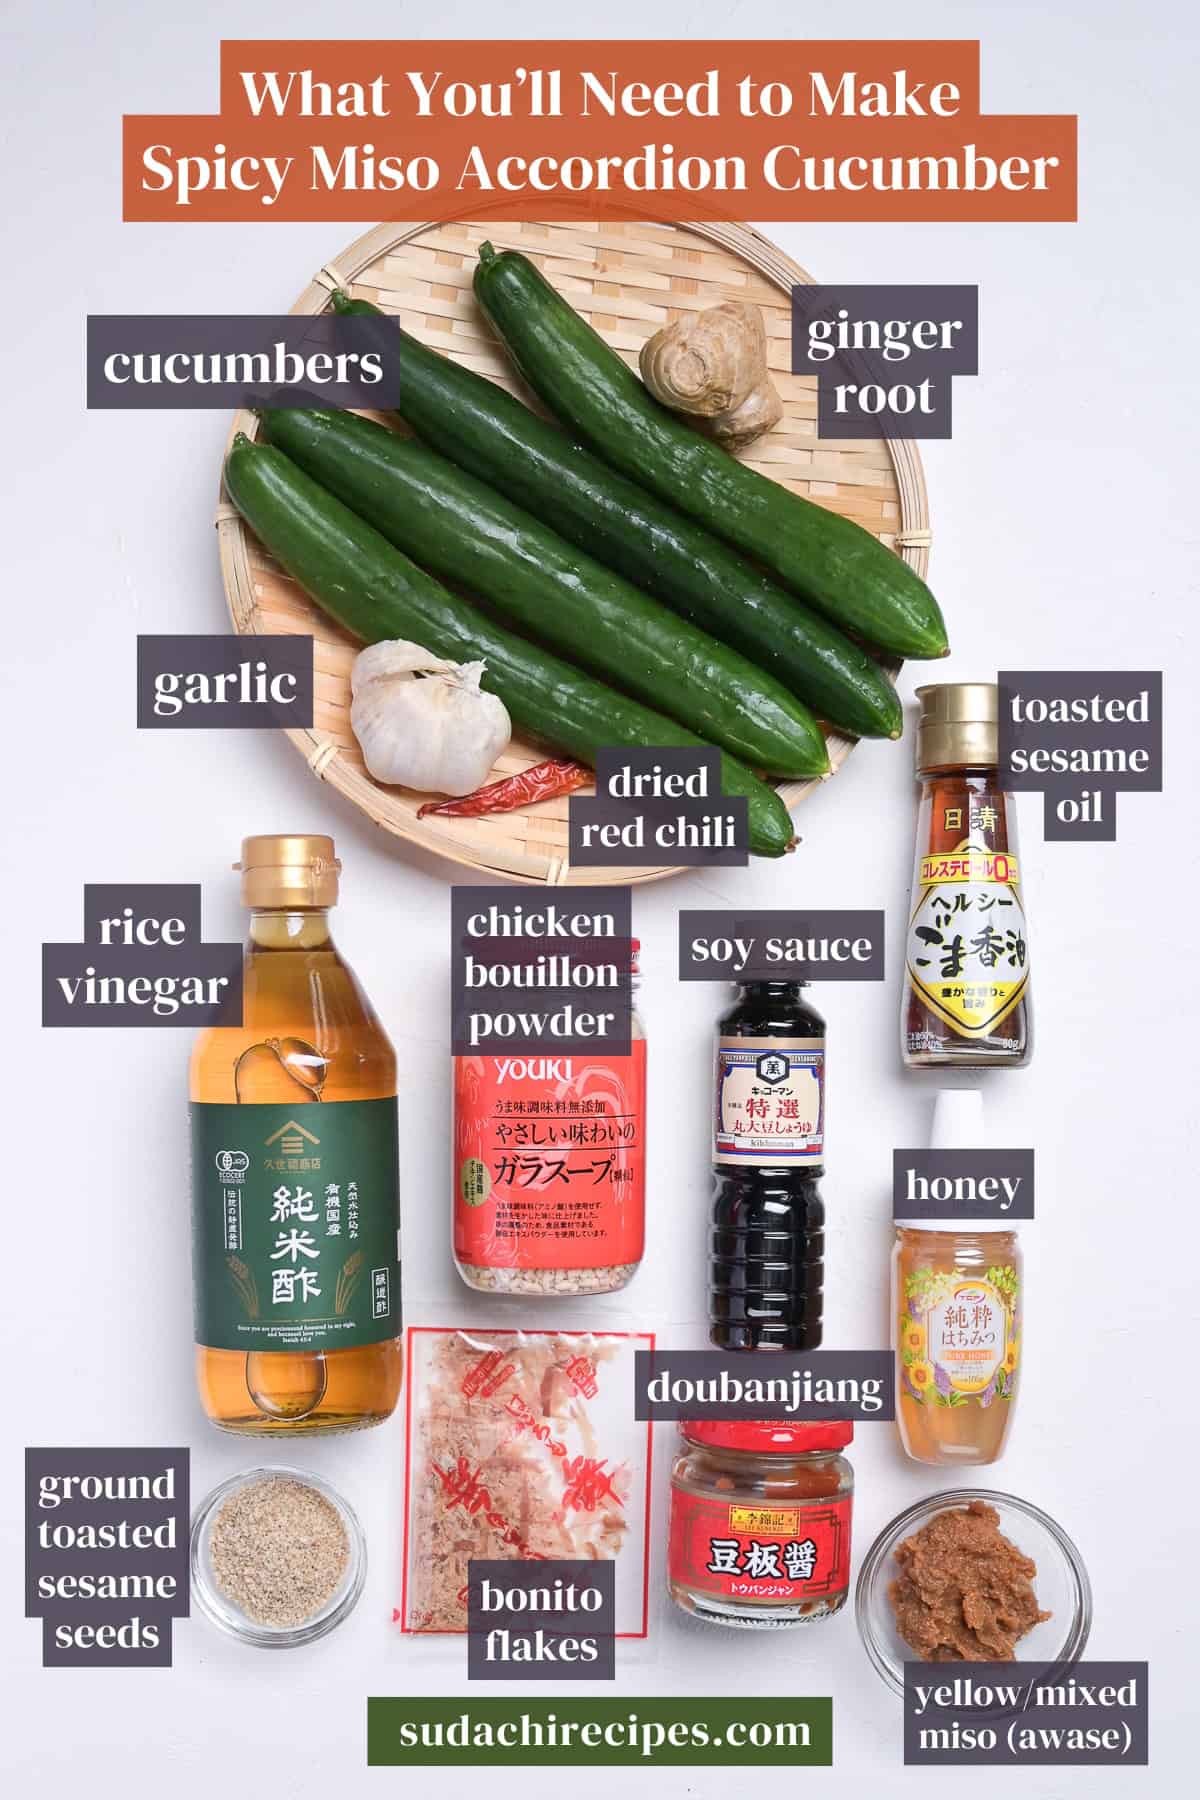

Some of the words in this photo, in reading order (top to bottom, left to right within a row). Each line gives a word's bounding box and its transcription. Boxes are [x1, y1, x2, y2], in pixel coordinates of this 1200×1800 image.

[944, 806, 998, 833] 日清
[931, 893, 1014, 913] ヘルシー
[914, 913, 1026, 979] ごま香油
[496, 1100, 606, 1114] うま味調味料無添加
[745, 1097, 801, 1119] 特選
[496, 1122, 635, 1145] やさしい味わいの
[733, 1119, 812, 1134] 丸大豆しょうゆ
[494, 1154, 615, 1186] ガラスープ
[324, 1183, 342, 1236] 有機国産
[269, 1185, 322, 1305] 純米酢
[944, 1304, 993, 1329] 純粋
[942, 1330, 996, 1347] はちみつ
[706, 1538, 817, 1582] 豆板醤
